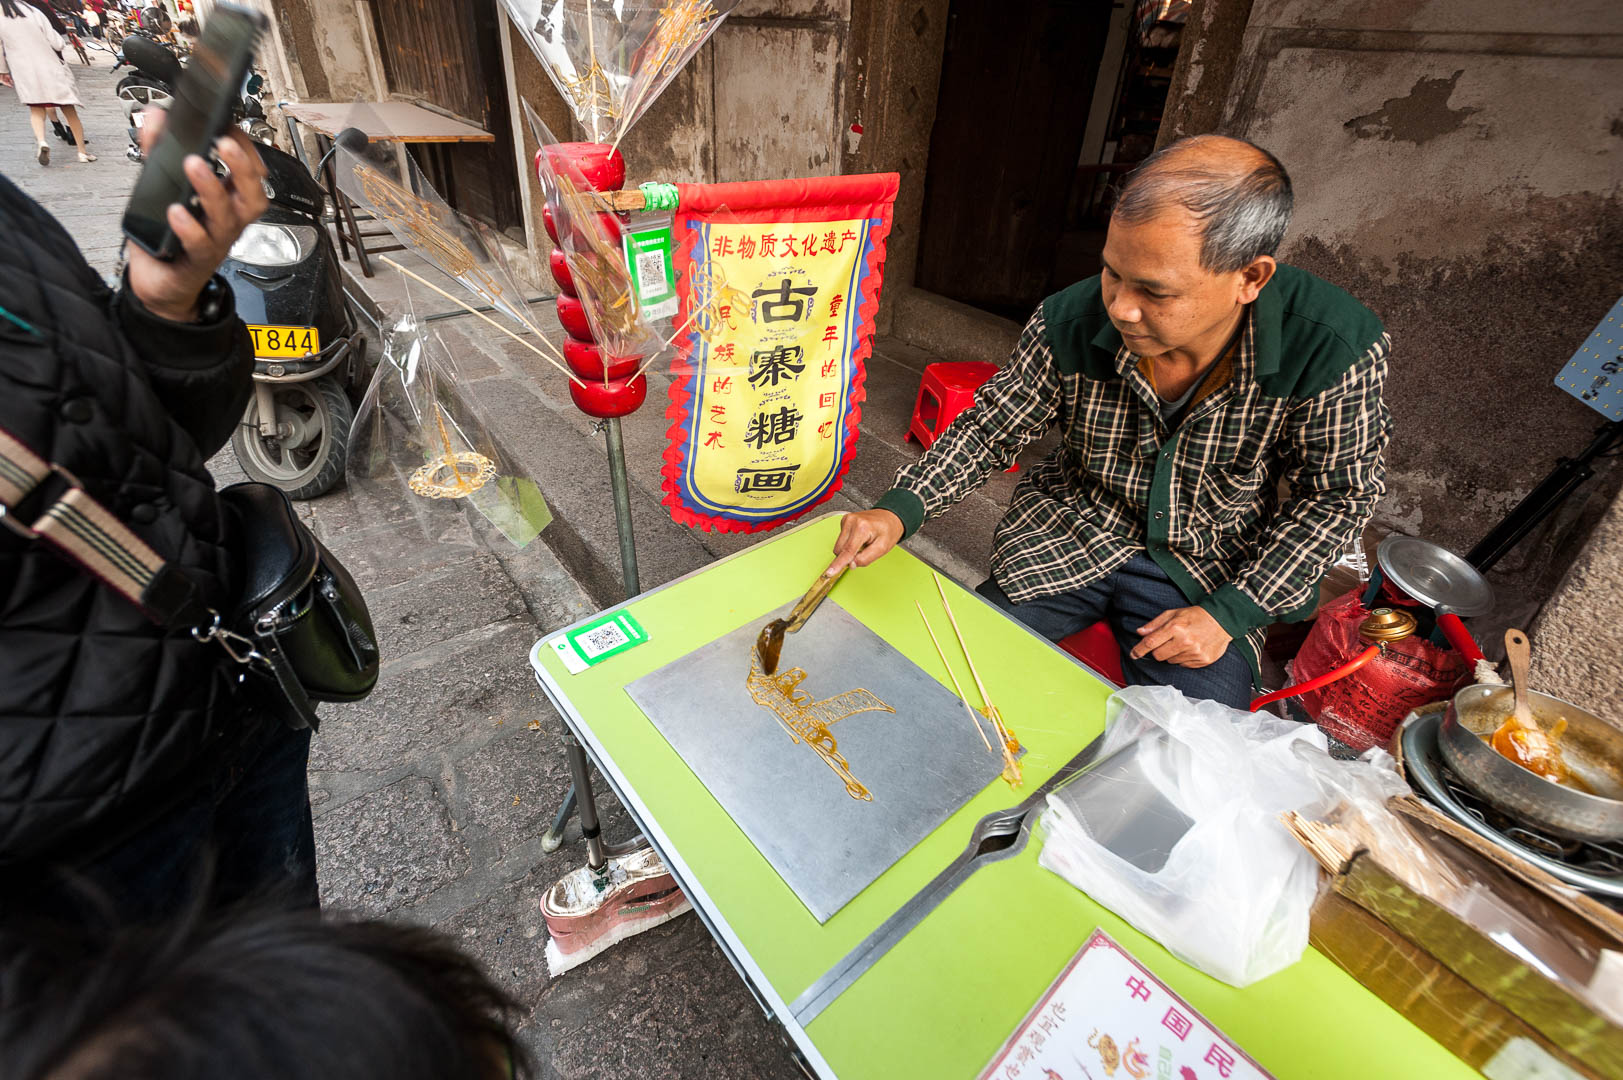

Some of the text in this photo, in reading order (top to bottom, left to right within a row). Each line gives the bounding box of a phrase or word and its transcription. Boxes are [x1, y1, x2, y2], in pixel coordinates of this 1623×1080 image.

[712, 228, 857, 260] 非物质文化遗产
[249, 328, 313, 353] T844
[704, 305, 737, 450] 民族的艺术
[736, 278, 818, 493] 古寨糖画
[818, 294, 843, 440] 童年的回忆
[1125, 975, 1236, 1078] 中国民
